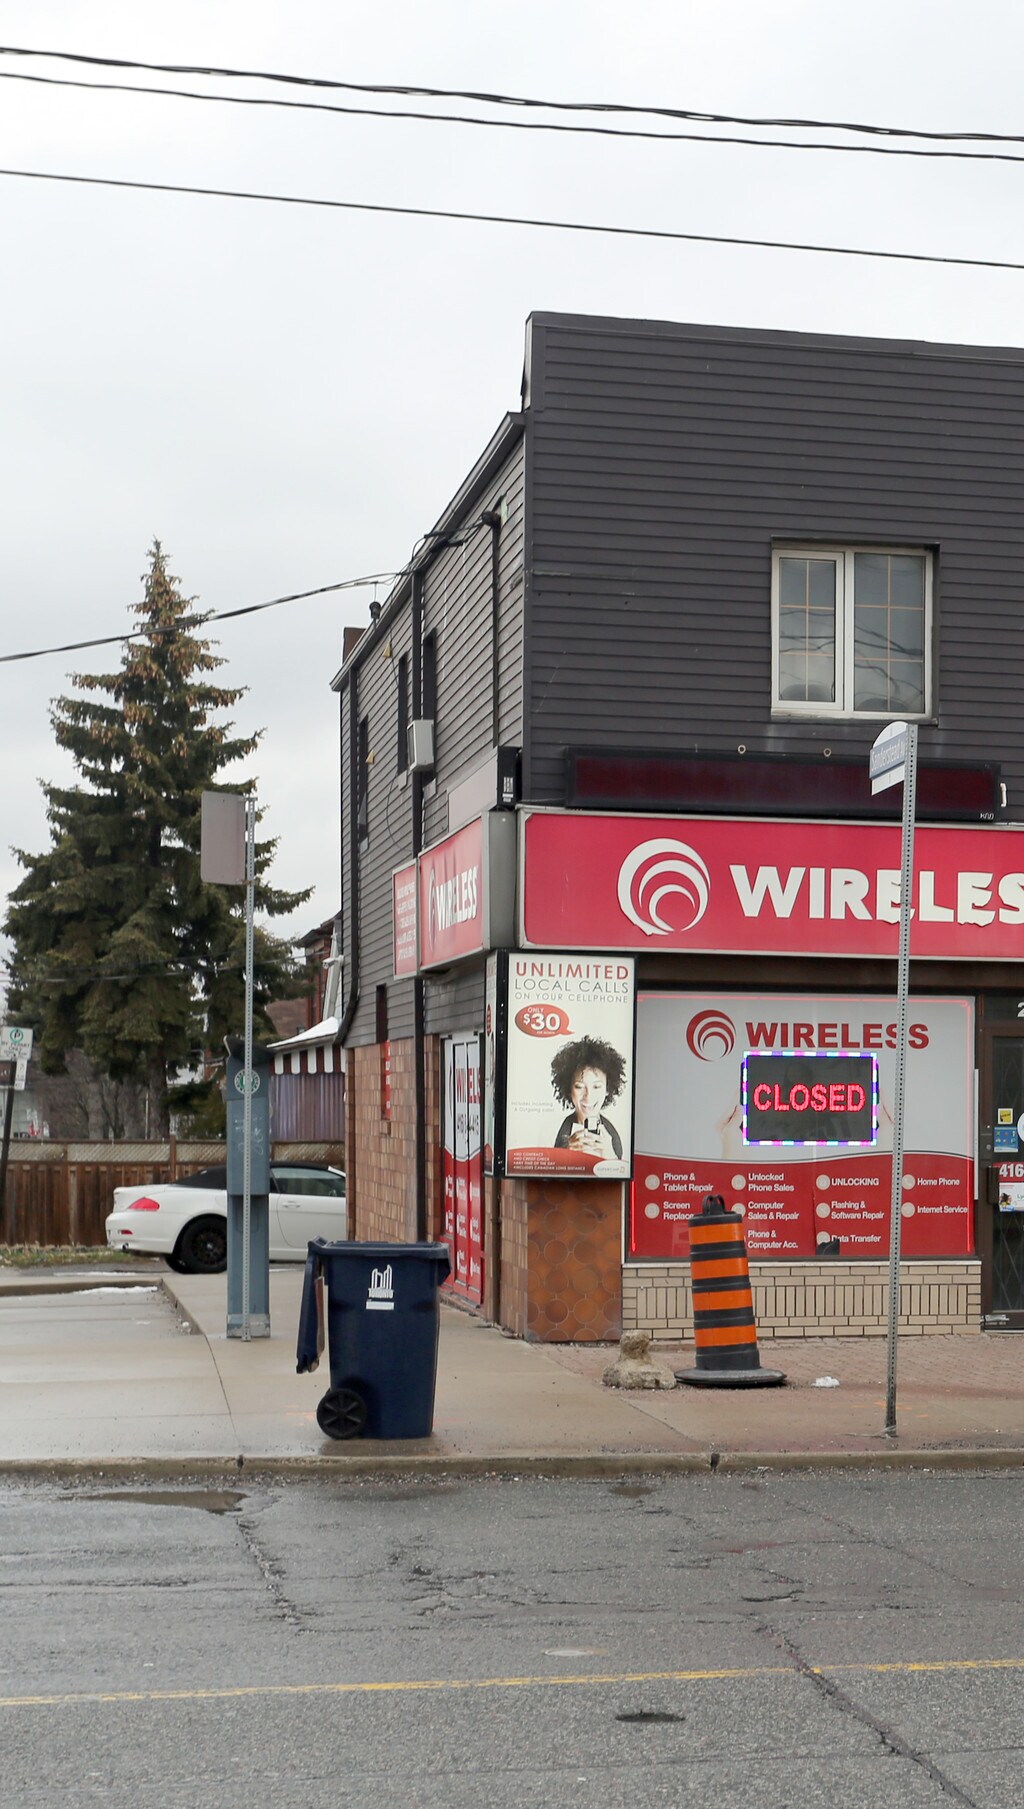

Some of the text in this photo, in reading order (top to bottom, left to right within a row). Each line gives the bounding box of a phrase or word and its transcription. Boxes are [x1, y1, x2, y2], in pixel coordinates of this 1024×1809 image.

[516, 962, 629, 980] UNLIMITED
[515, 978, 629, 994] LOCAL CALLS
[514, 991, 628, 1003] ON YOUR CELLPHONE
[523, 1012, 561, 1031] $30
[745, 1021, 930, 1050] WIRELESS
[753, 1083, 866, 1112] CLOSED
[663, 1173, 696, 1181] Phone &
[748, 1173, 784, 1181] Unlocked
[917, 1177, 960, 1186] Home Phone
[831, 1178, 879, 1187] UNLOCKING
[664, 1183, 714, 1194] Tablet Repair
[748, 1184, 794, 1192] Phone Sales
[663, 1201, 690, 1209] Screen
[748, 1202, 784, 1211] Computer
[831, 1201, 860, 1210] Flashing
[917, 1205, 968, 1213] Internet Service
[748, 1212, 799, 1221] Sales & Repair
[831, 1211, 884, 1221] Software Repair
[748, 1230, 776, 1238] Phone &
[850, 1234, 881, 1242] Transfer
[748, 1241, 798, 1250] Computer Acc.
